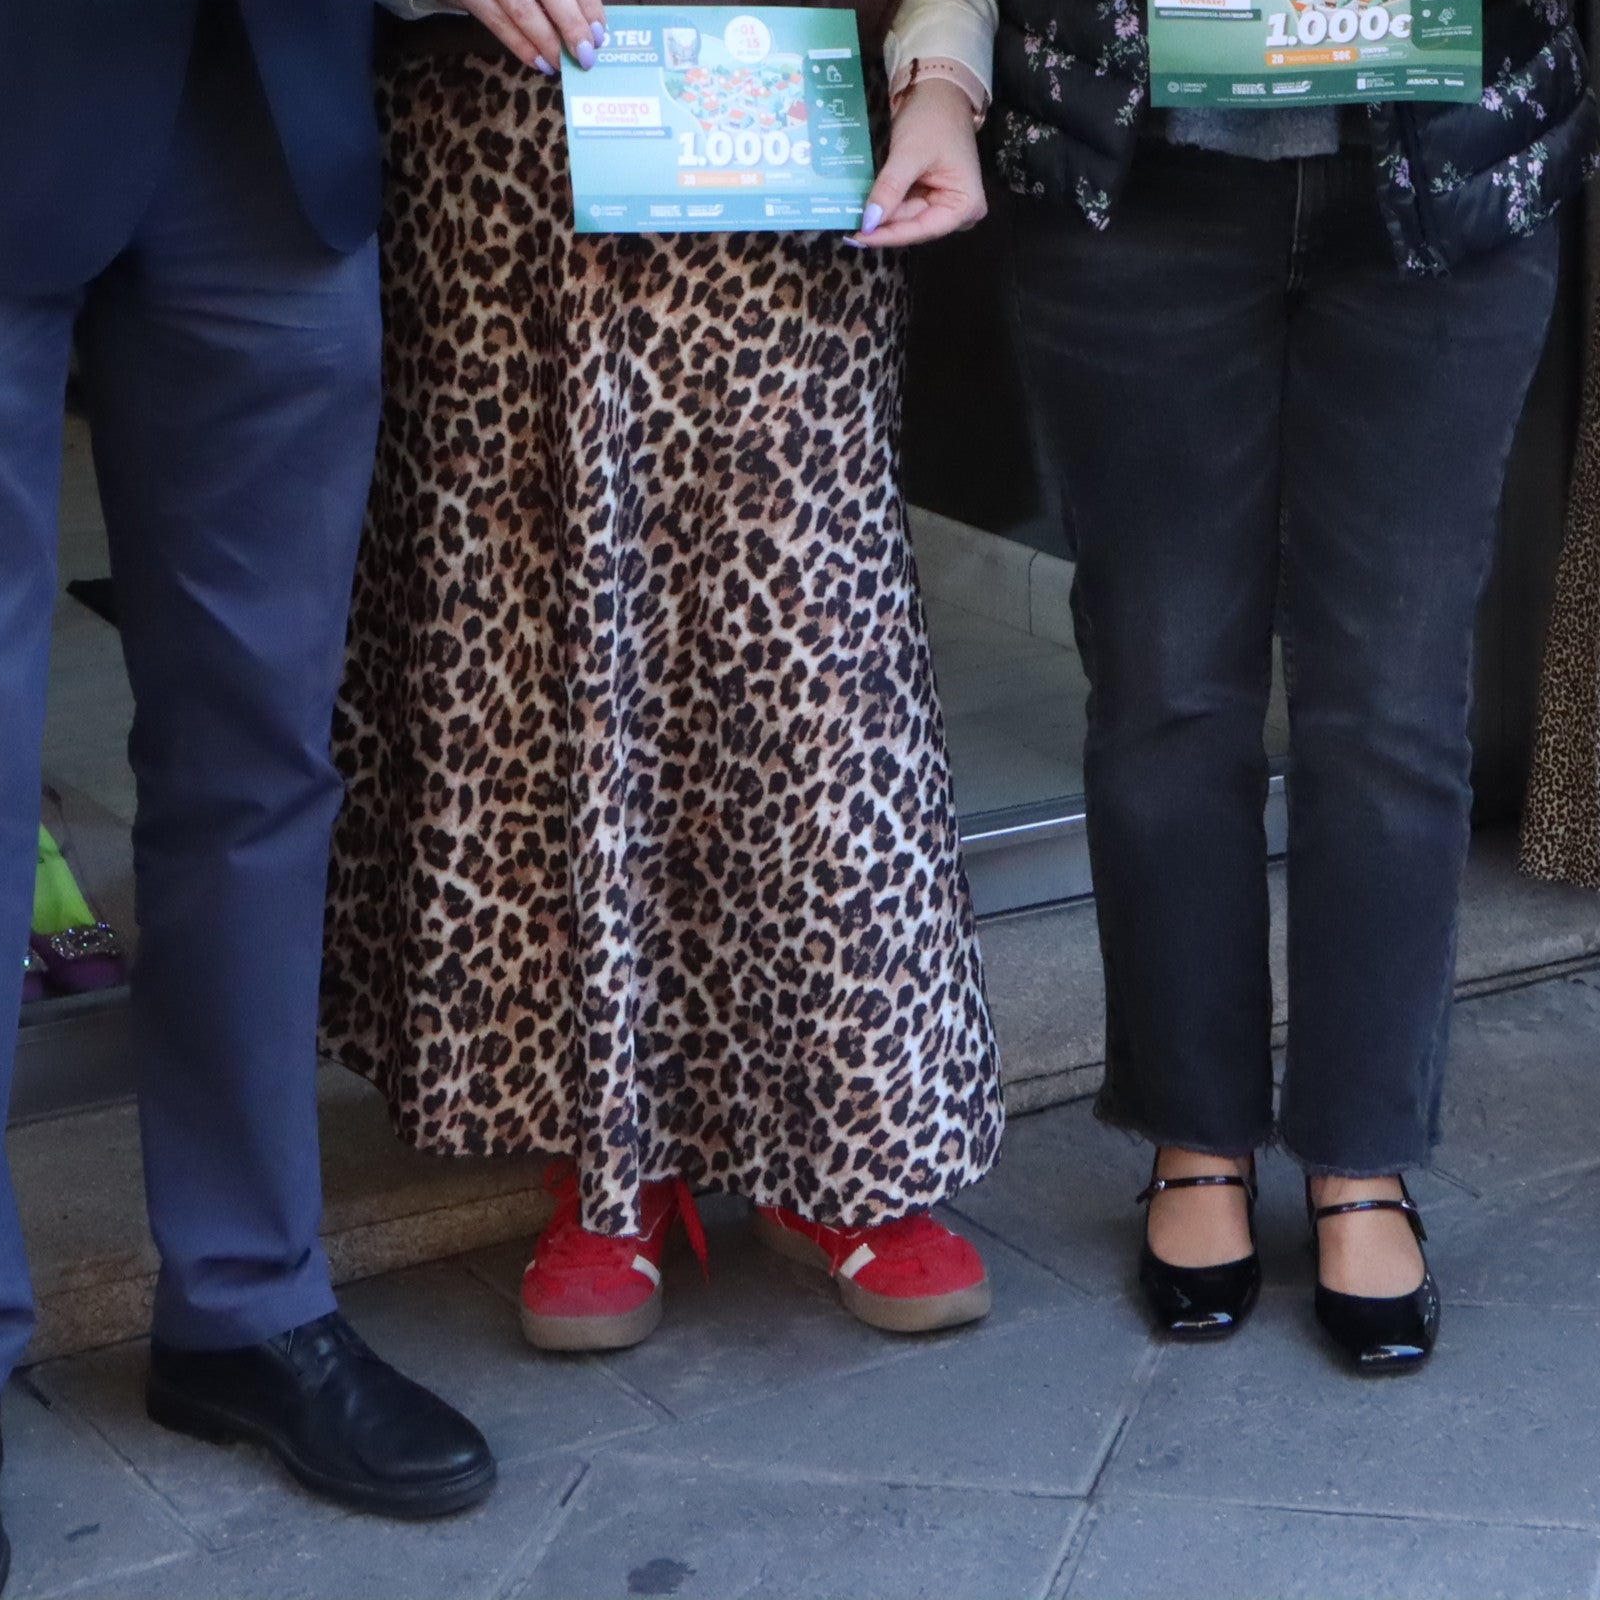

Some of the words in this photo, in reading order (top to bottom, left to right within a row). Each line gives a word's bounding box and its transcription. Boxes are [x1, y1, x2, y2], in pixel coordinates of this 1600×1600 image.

[1266, 7, 1413, 46] 1.000€
[614, 30, 651, 46] TEU
[598, 52, 658, 63] COMERCIO
[1271, 54, 1284, 65] 20
[1406, 78, 1439, 86] ABANCA
[583, 103, 592, 114] O
[597, 103, 649, 115] COUTO
[678, 131, 811, 167] 1.000€
